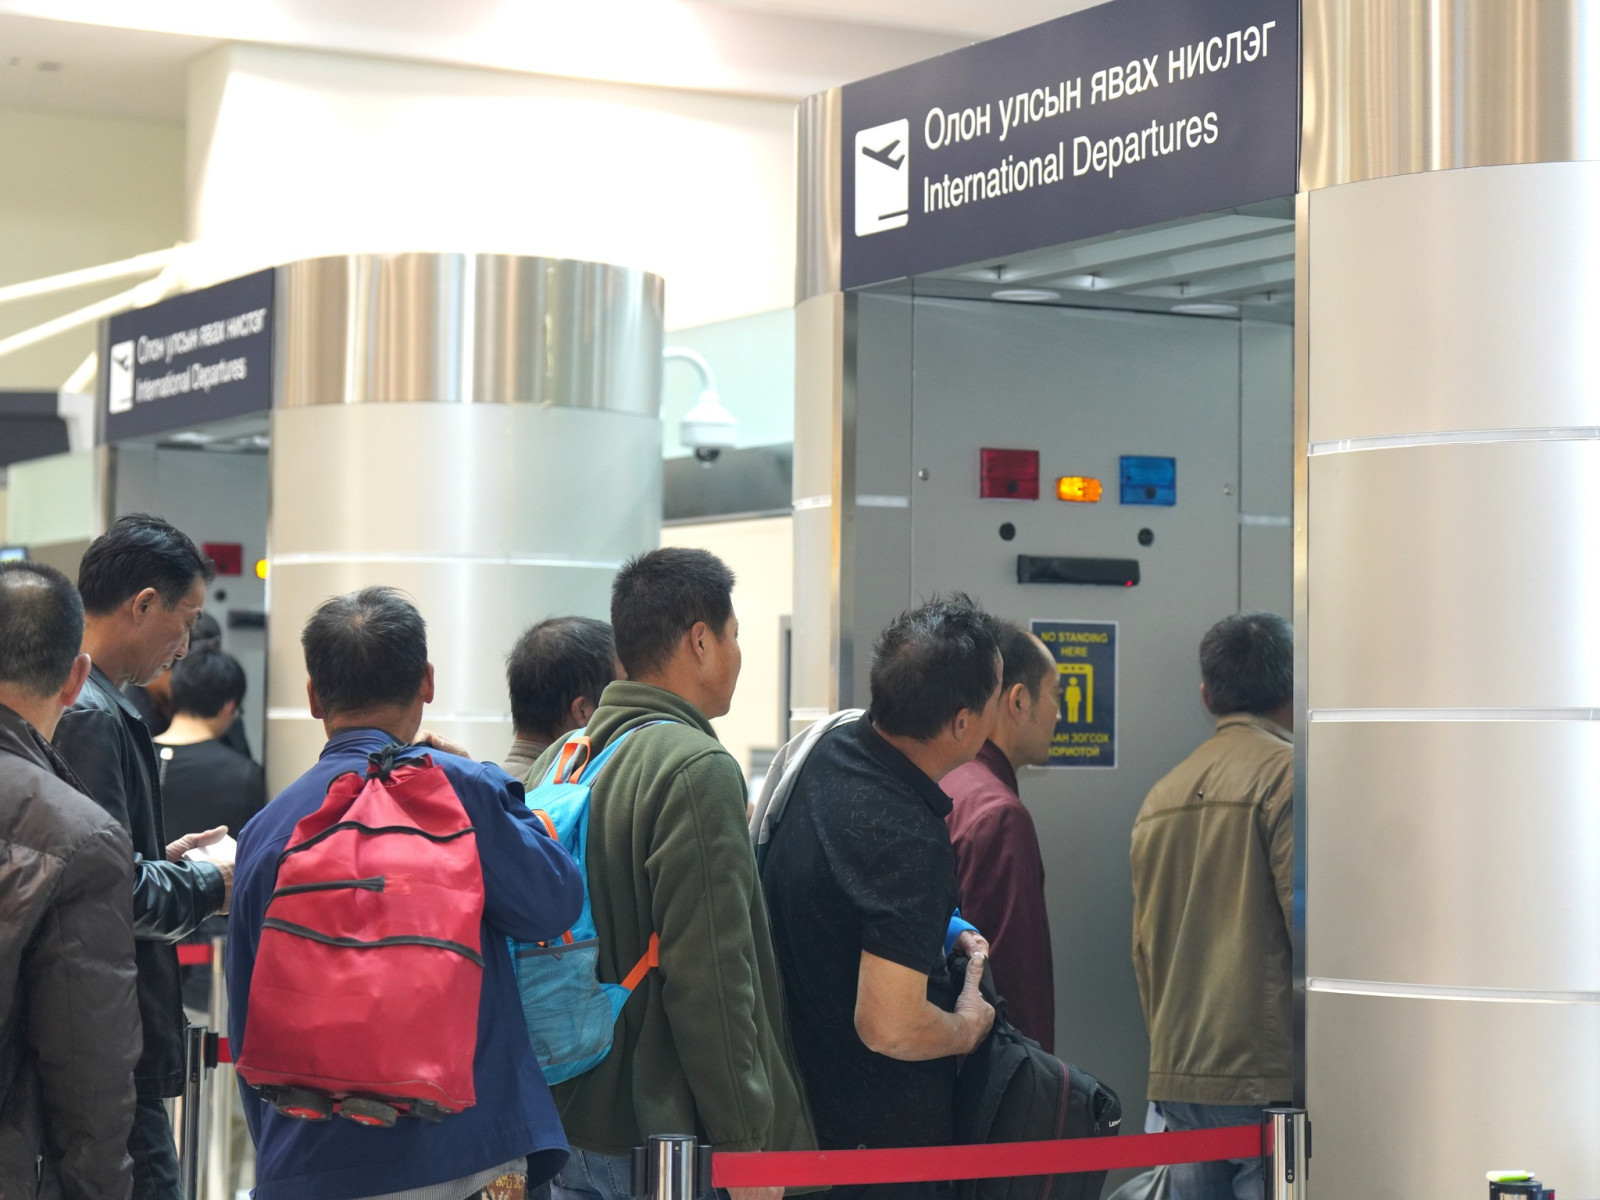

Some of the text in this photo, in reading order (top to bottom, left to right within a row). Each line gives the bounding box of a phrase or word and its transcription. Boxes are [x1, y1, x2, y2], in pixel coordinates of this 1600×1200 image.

[924, 20, 1276, 150] Олон улсын явах нислэг
[924, 111, 1219, 213] International Departures
[135, 357, 247, 403] International Departures
[1041, 631, 1108, 643] NO STANDING
[1061, 646, 1088, 657] HERE
